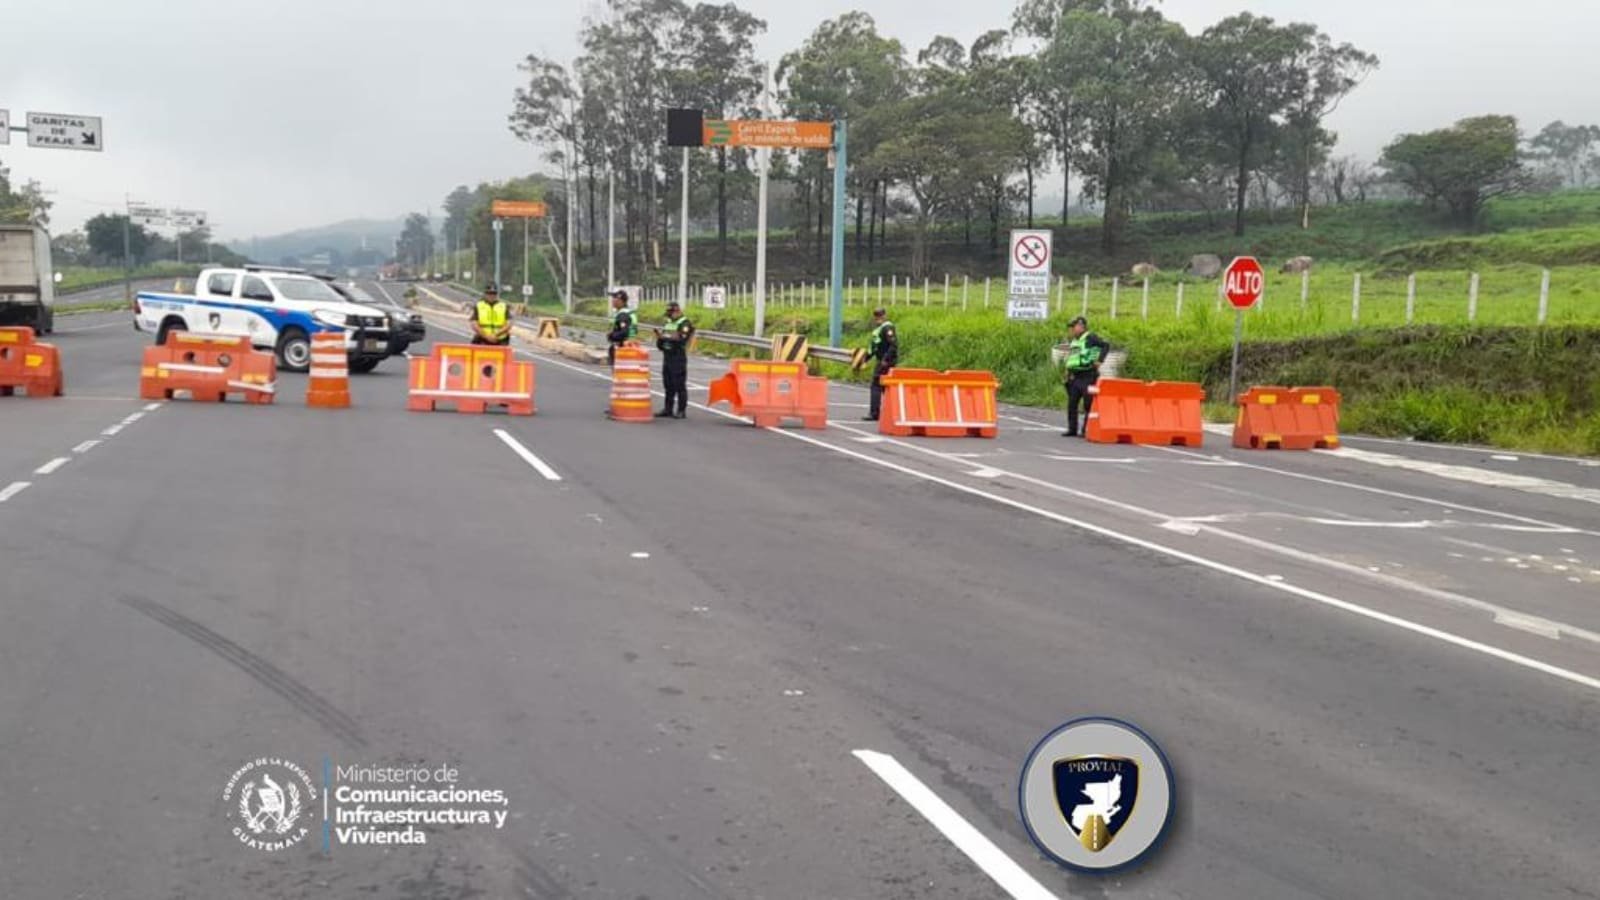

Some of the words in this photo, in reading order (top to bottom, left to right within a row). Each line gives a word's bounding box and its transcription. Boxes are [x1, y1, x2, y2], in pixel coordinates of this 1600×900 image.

[32, 117, 85, 127] GARITAS
[738, 122, 762, 135] Carril
[36, 136, 75, 145] PEAJE
[1226, 270, 1262, 295] ALTO
